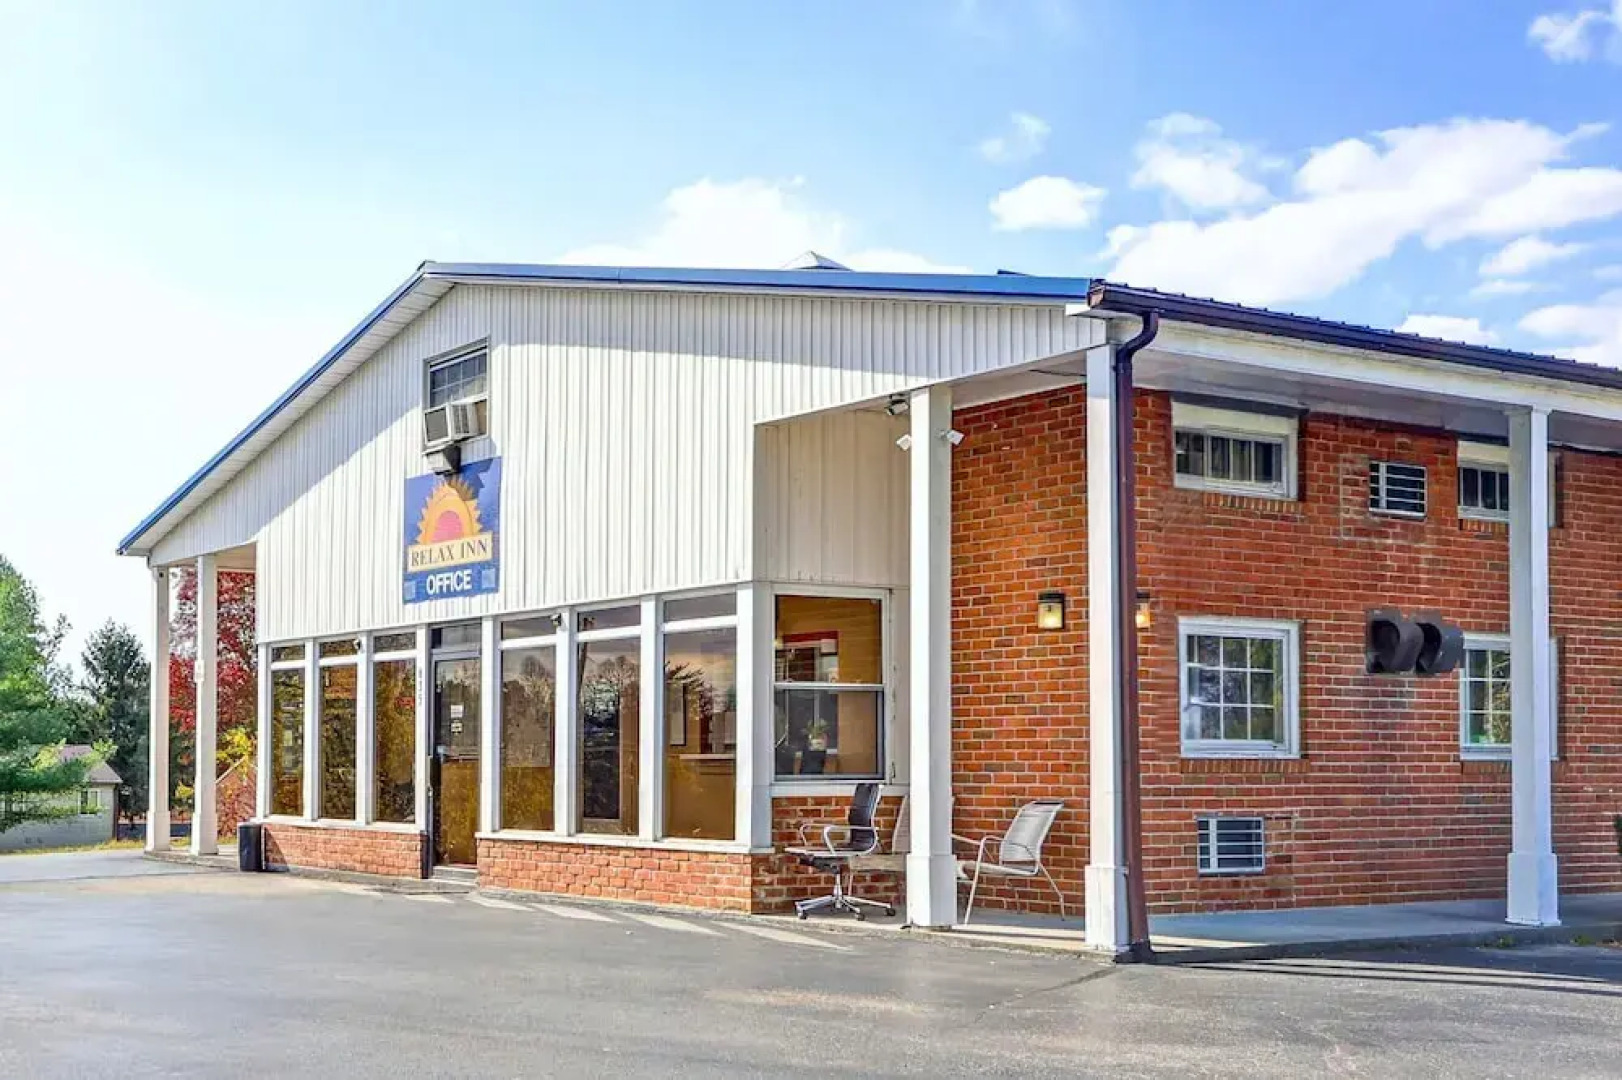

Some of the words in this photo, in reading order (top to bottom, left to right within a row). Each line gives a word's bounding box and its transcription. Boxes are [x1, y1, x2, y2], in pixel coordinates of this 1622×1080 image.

[411, 544, 455, 567] RELAX
[460, 538, 488, 559] INN
[426, 568, 473, 596] OFFICE
